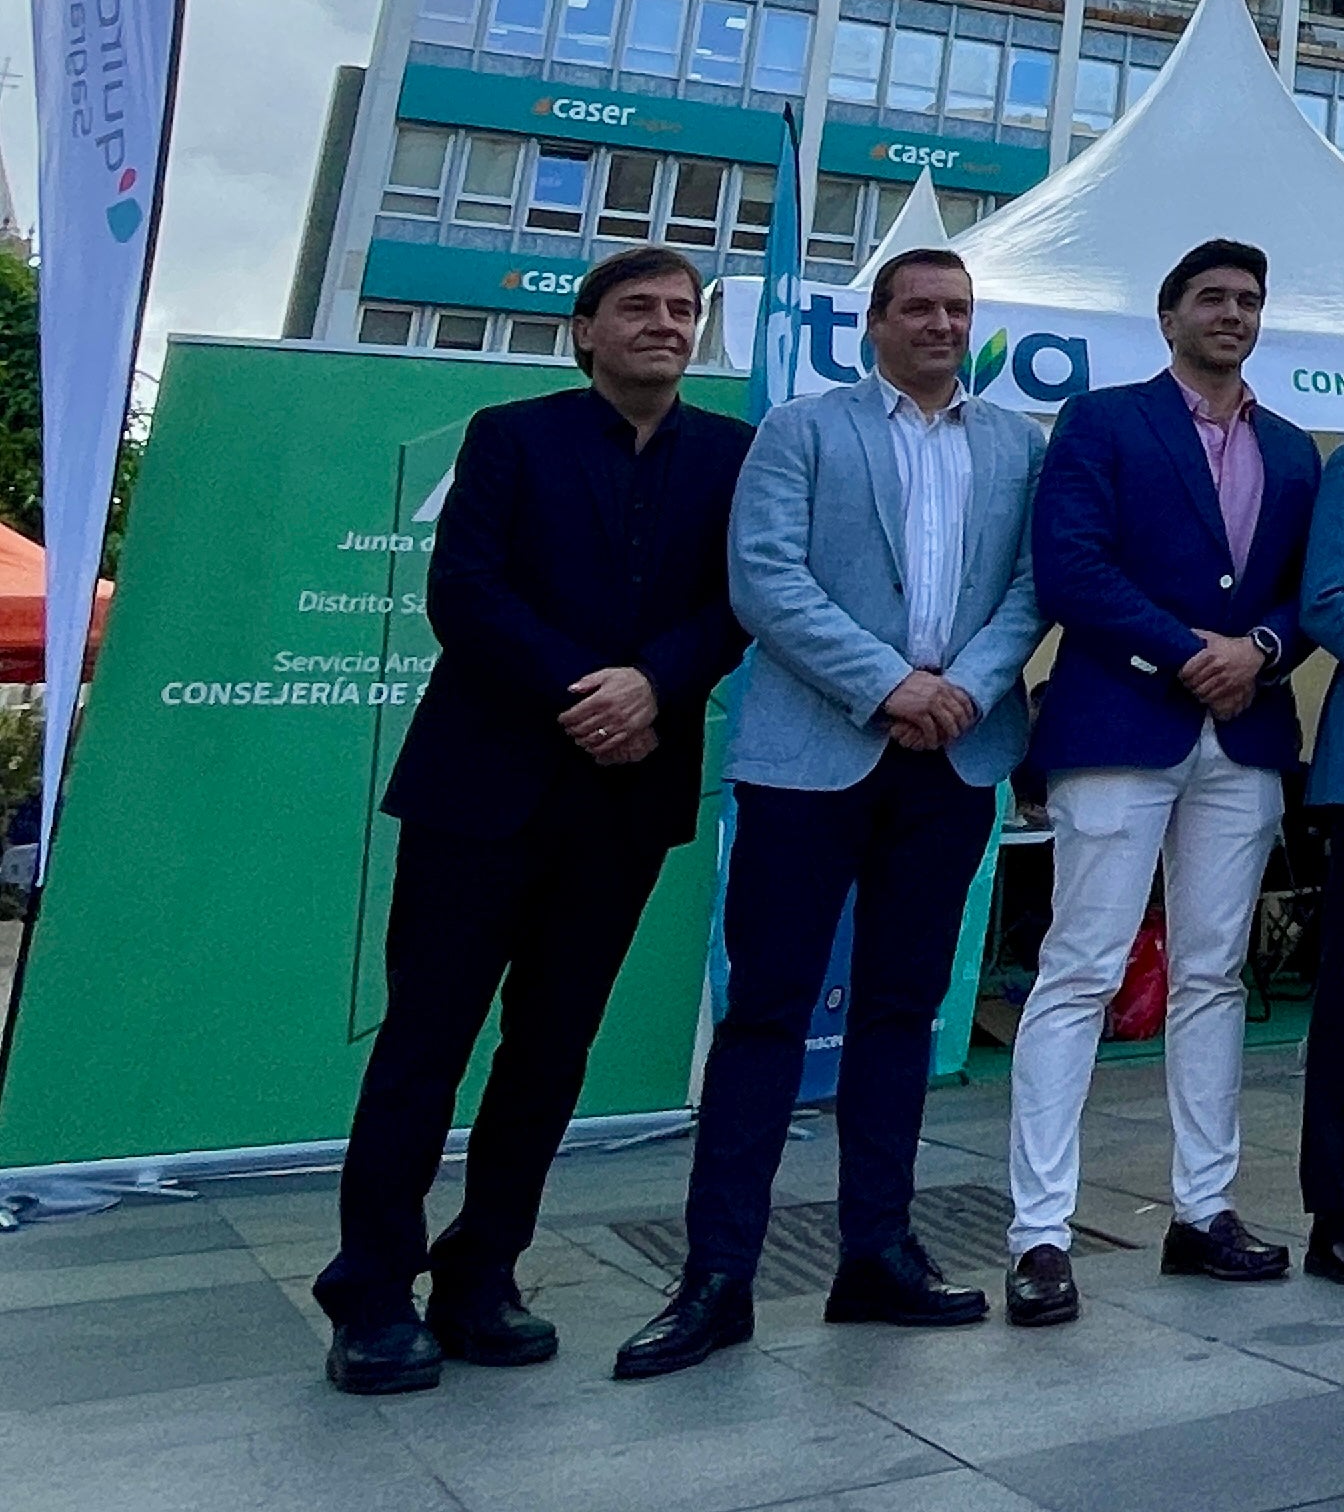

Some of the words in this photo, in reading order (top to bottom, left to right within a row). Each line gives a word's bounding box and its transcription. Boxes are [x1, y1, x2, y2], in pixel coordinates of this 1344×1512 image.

[552, 98, 637, 126] caser
[888, 143, 960, 169] caser
[336, 531, 413, 552] Junta
[299, 590, 393, 614] Distrito
[273, 650, 380, 673] Servicio
[160, 676, 360, 706] CONSEJERÍA
[368, 682, 409, 706] DE
